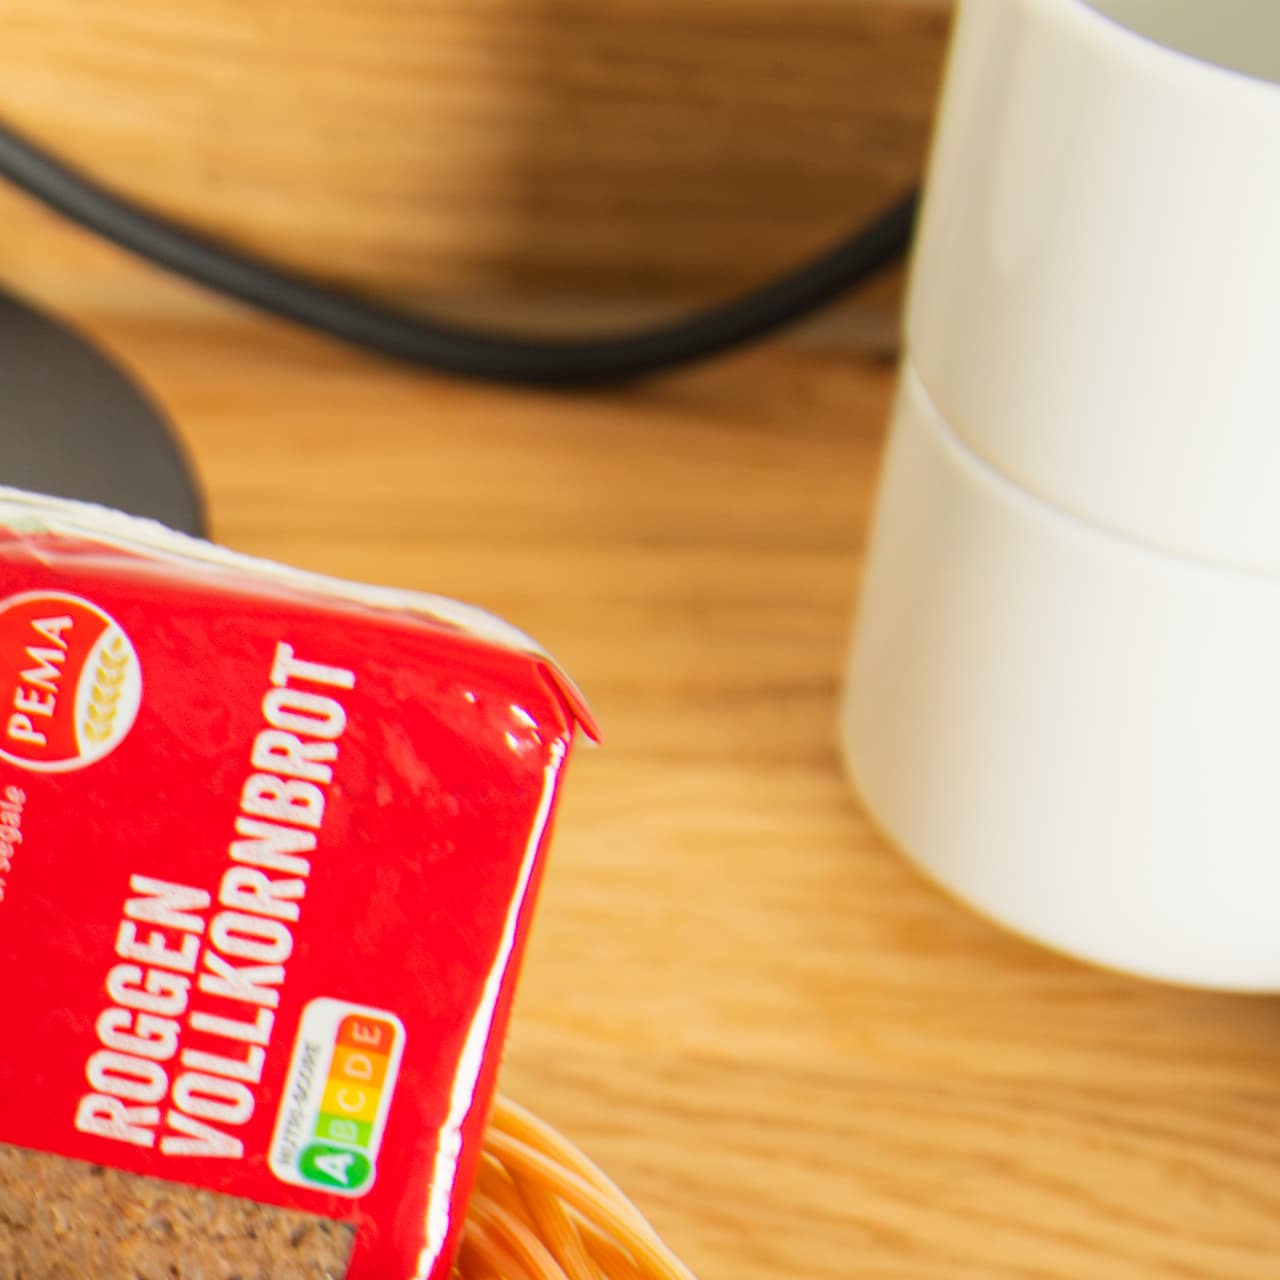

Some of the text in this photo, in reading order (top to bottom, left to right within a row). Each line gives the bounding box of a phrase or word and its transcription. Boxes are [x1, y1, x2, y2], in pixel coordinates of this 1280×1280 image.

[7, 615, 74, 746] PEMA
[159, 640, 357, 1160] VOLLKORNBROT
[74, 872, 211, 1149] ROGGEN
[314, 1021, 382, 1185] A B C D E
